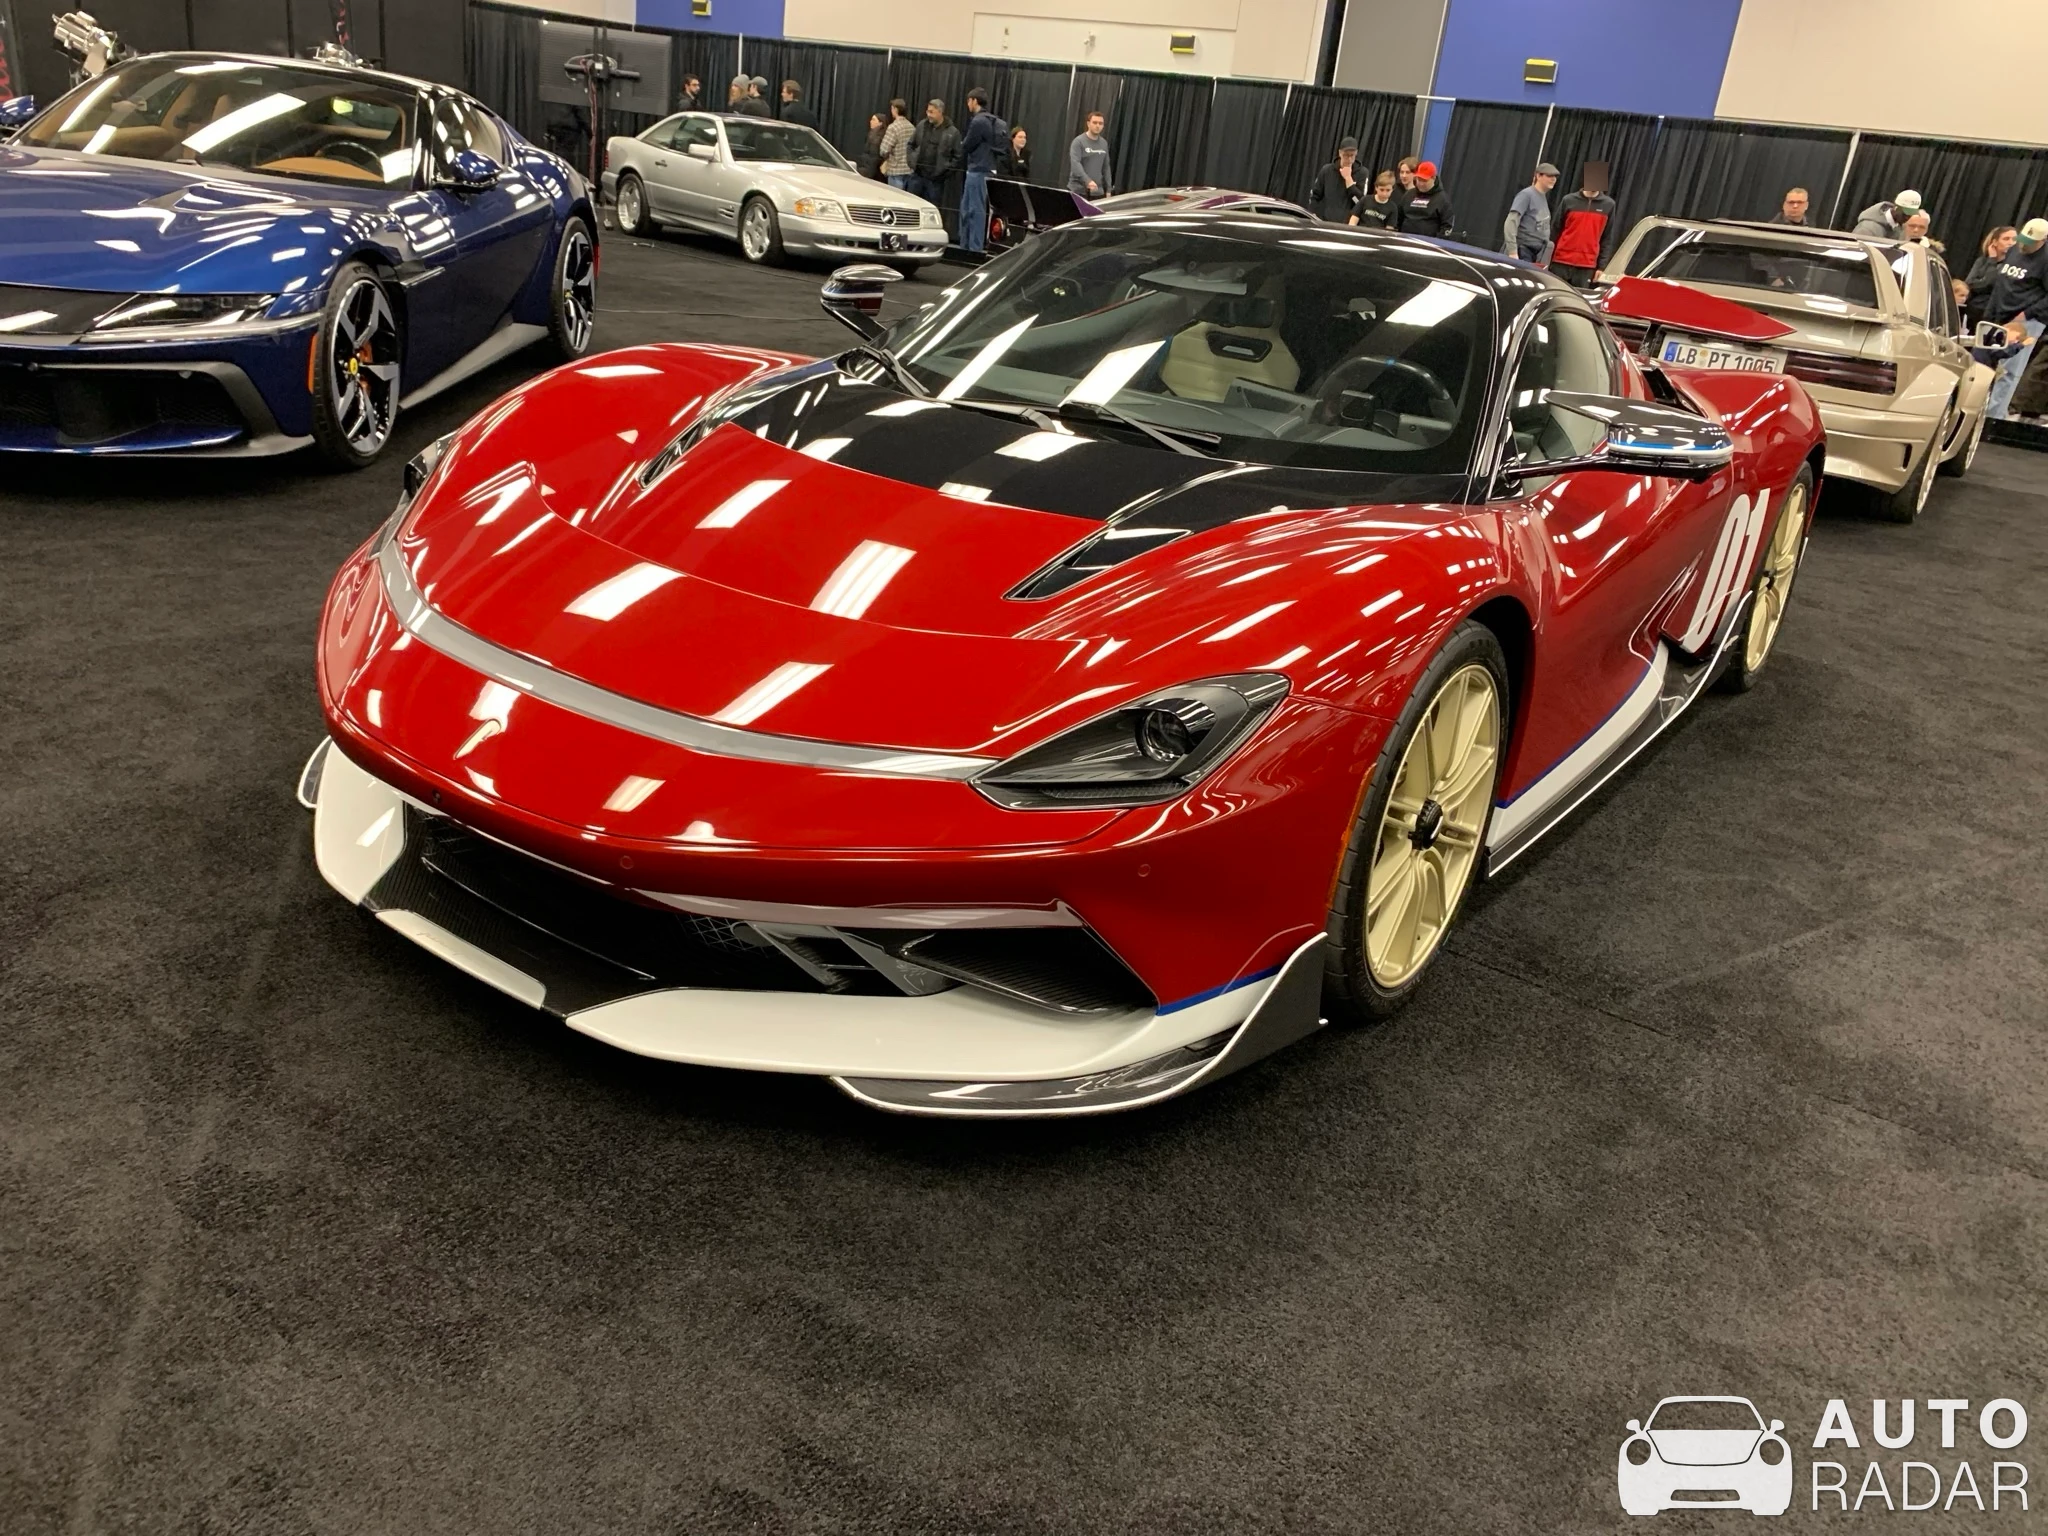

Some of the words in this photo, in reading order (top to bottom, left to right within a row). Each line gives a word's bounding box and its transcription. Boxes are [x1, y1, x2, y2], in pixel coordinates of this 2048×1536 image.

[2001, 263, 2028, 280] BOSS
[1675, 346, 1698, 365] LB
[1707, 351, 1730, 370] PT
[1734, 355, 1775, 373] 1005
[1681, 487, 1771, 653] 01
